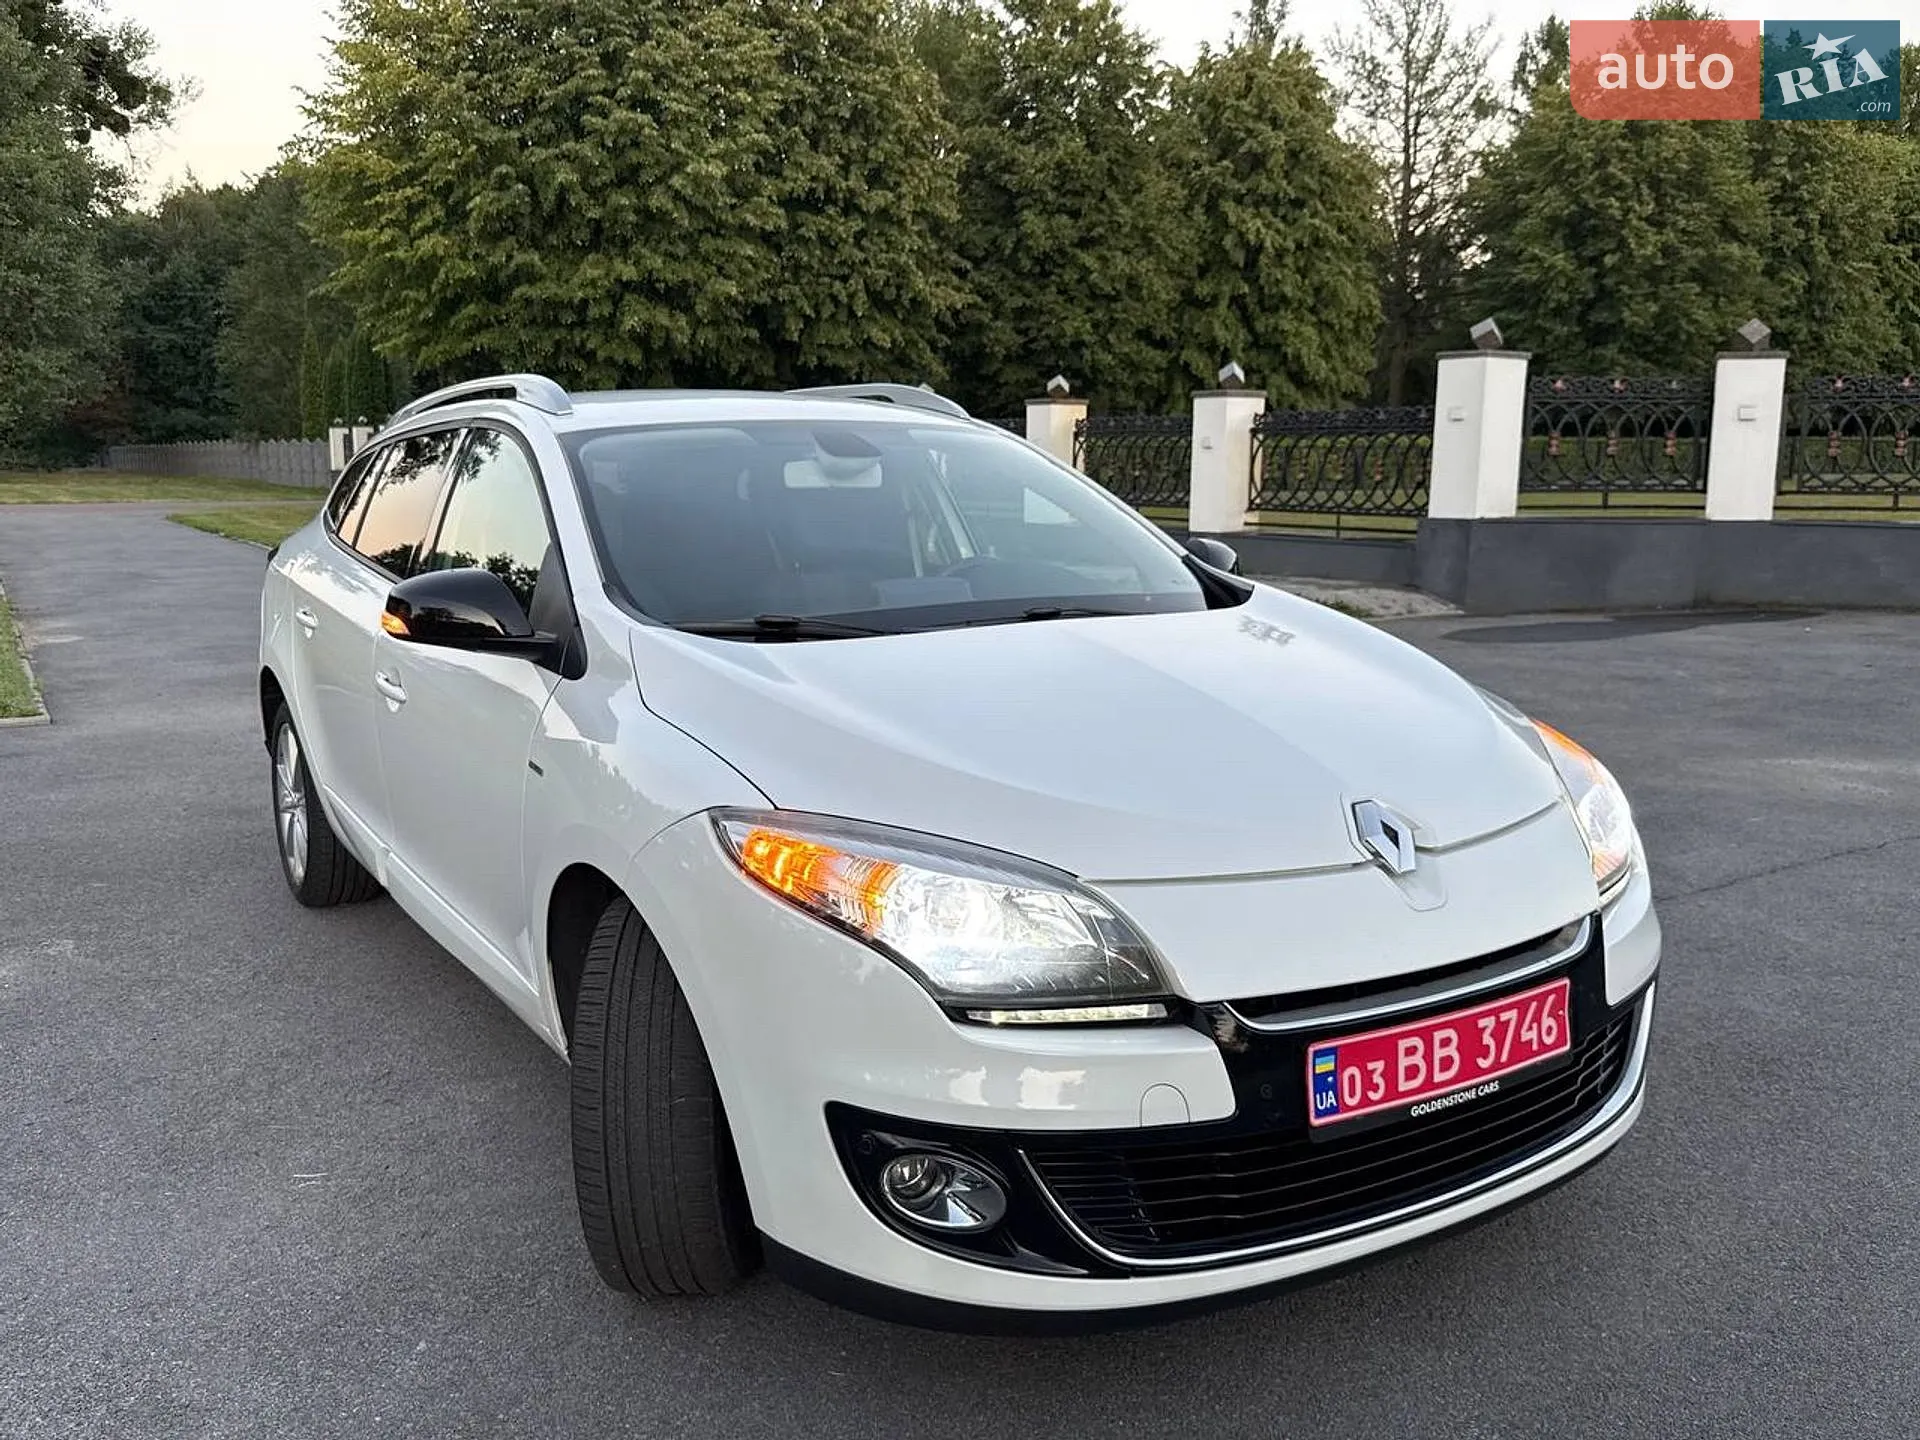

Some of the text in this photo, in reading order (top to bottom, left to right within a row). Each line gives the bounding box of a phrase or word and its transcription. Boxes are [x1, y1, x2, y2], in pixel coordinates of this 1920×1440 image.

[1342, 993, 1559, 1107] 03 BB 3746
[1316, 1091, 1337, 1111] UA
[1411, 1080, 1500, 1117] GOLDENSTONE CARS
